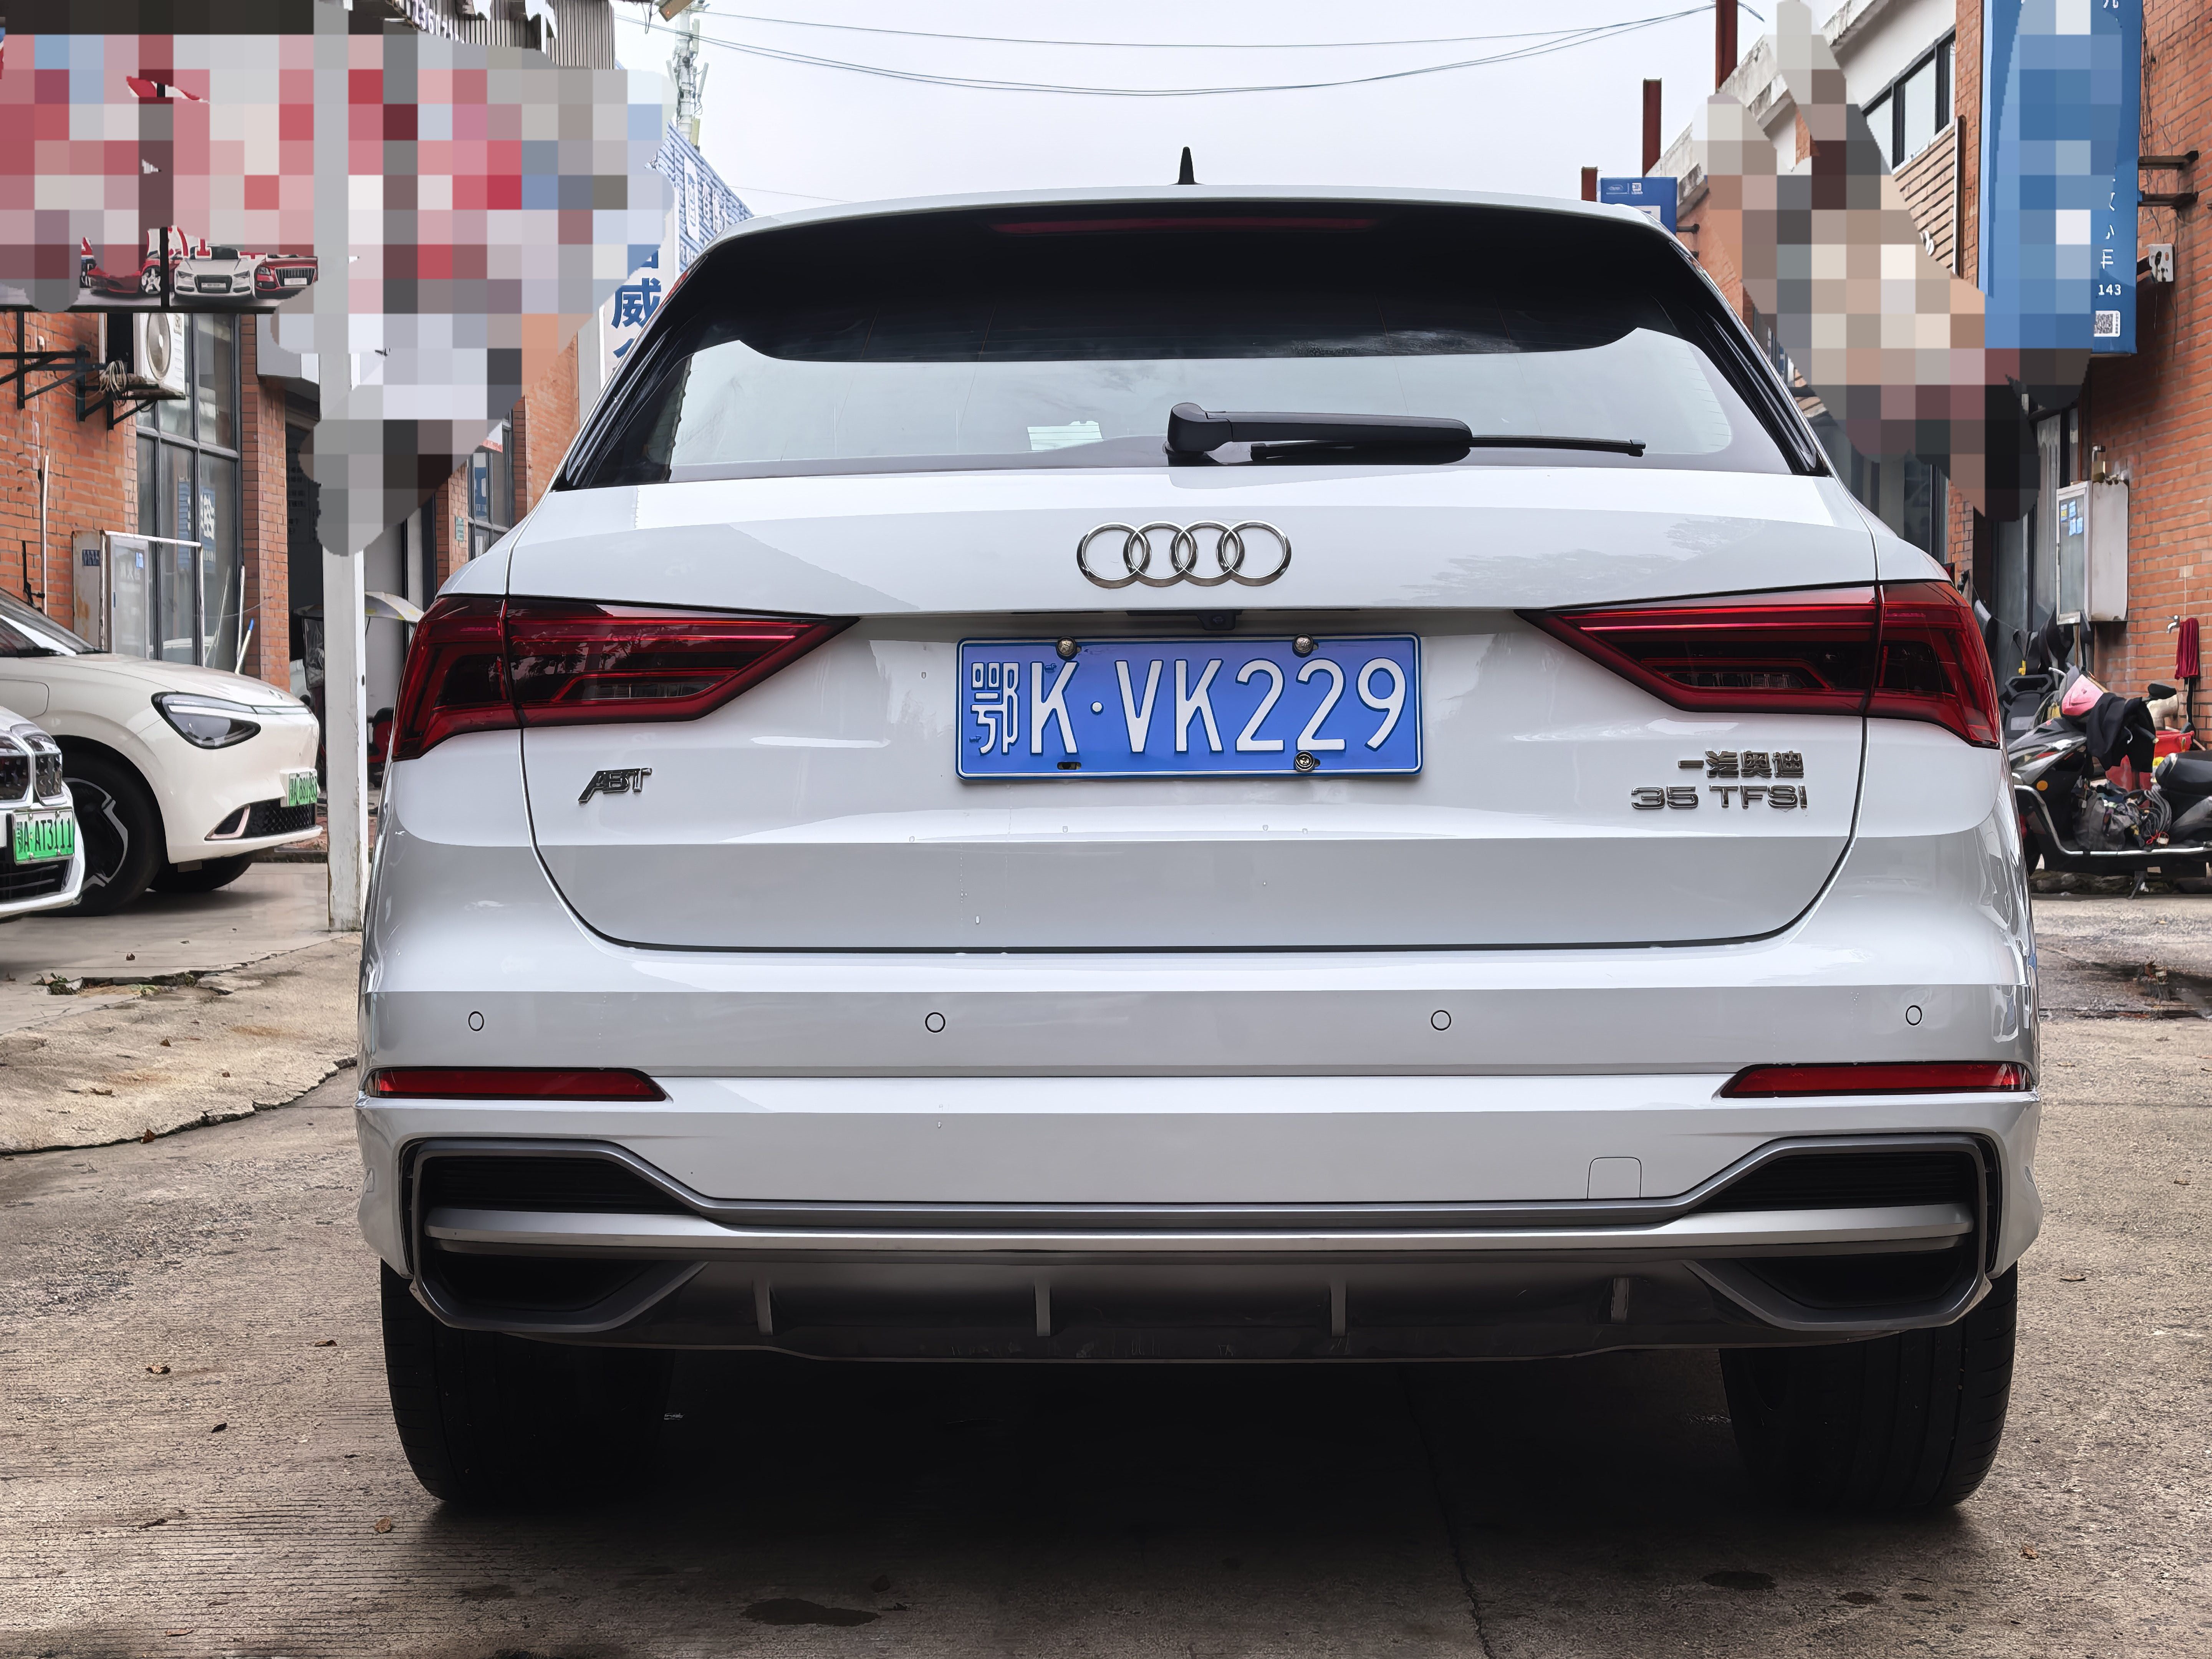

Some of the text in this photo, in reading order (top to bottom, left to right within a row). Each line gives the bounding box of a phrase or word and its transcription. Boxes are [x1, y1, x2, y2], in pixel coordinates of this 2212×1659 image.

[2098, 284, 2121, 295] 143
[1677, 750, 1804, 778] 一汽奥迪
[578, 768, 652, 804] ABT
[1631, 785, 1807, 810] 35 TFSI
